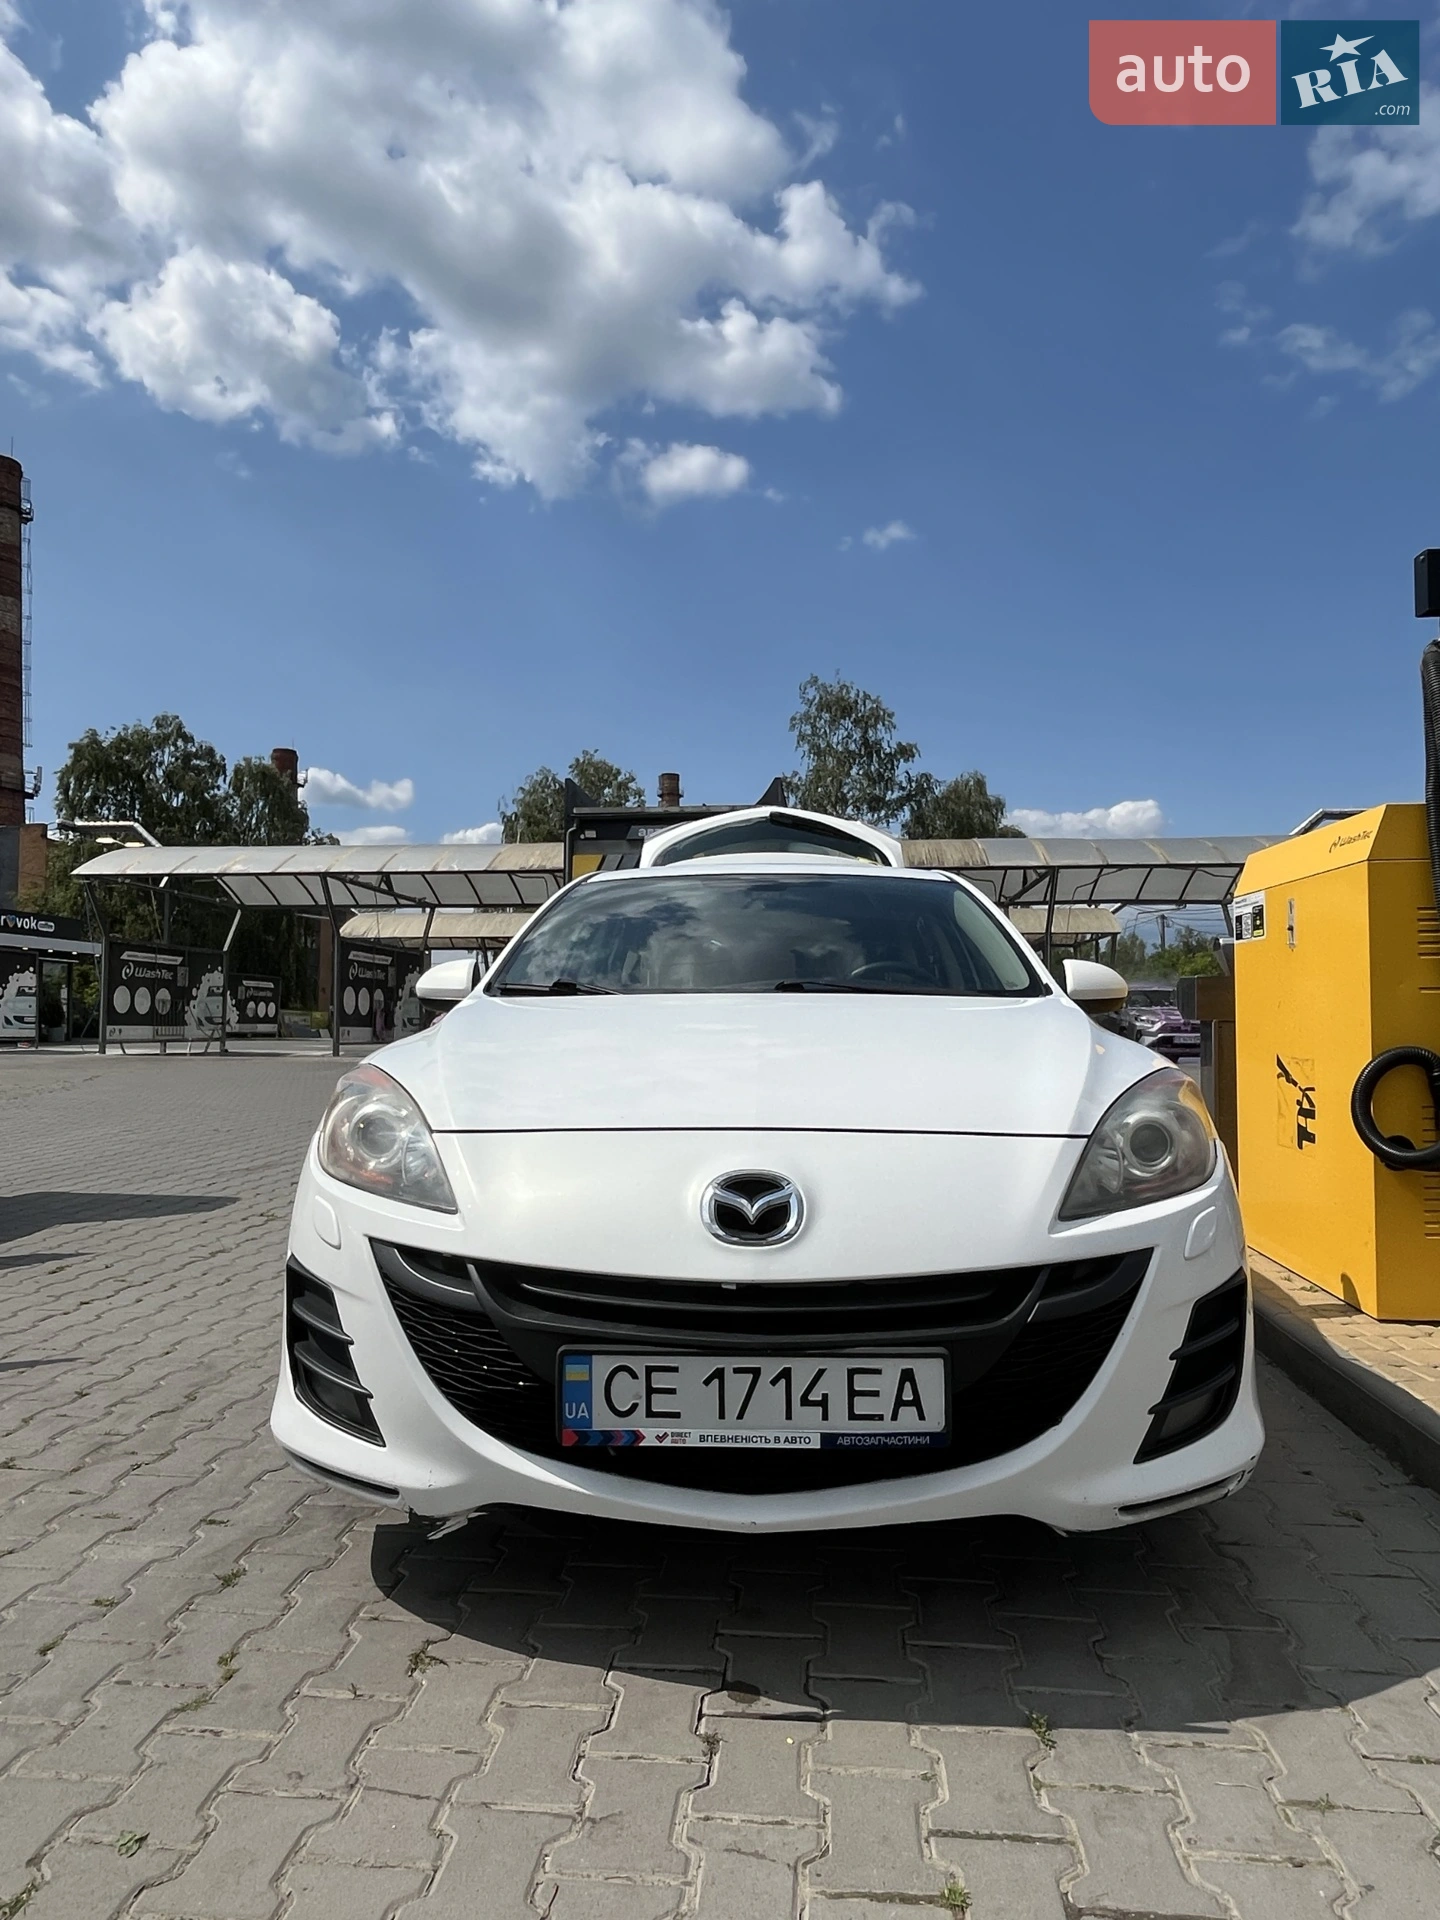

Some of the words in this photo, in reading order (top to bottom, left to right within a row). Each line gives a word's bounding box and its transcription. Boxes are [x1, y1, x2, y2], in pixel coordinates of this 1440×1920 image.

[603, 1364, 682, 1419] CE
[701, 1366, 829, 1422] 1714
[846, 1367, 926, 1422] EA
[565, 1402, 590, 1419] UA
[699, 1434, 771, 1444] ВПЕВНЕНІСТЬ
[774, 1436, 781, 1444] В
[783, 1436, 812, 1445] АВТО
[836, 1435, 931, 1446] АВТОЗАПЧАСТИНИ
